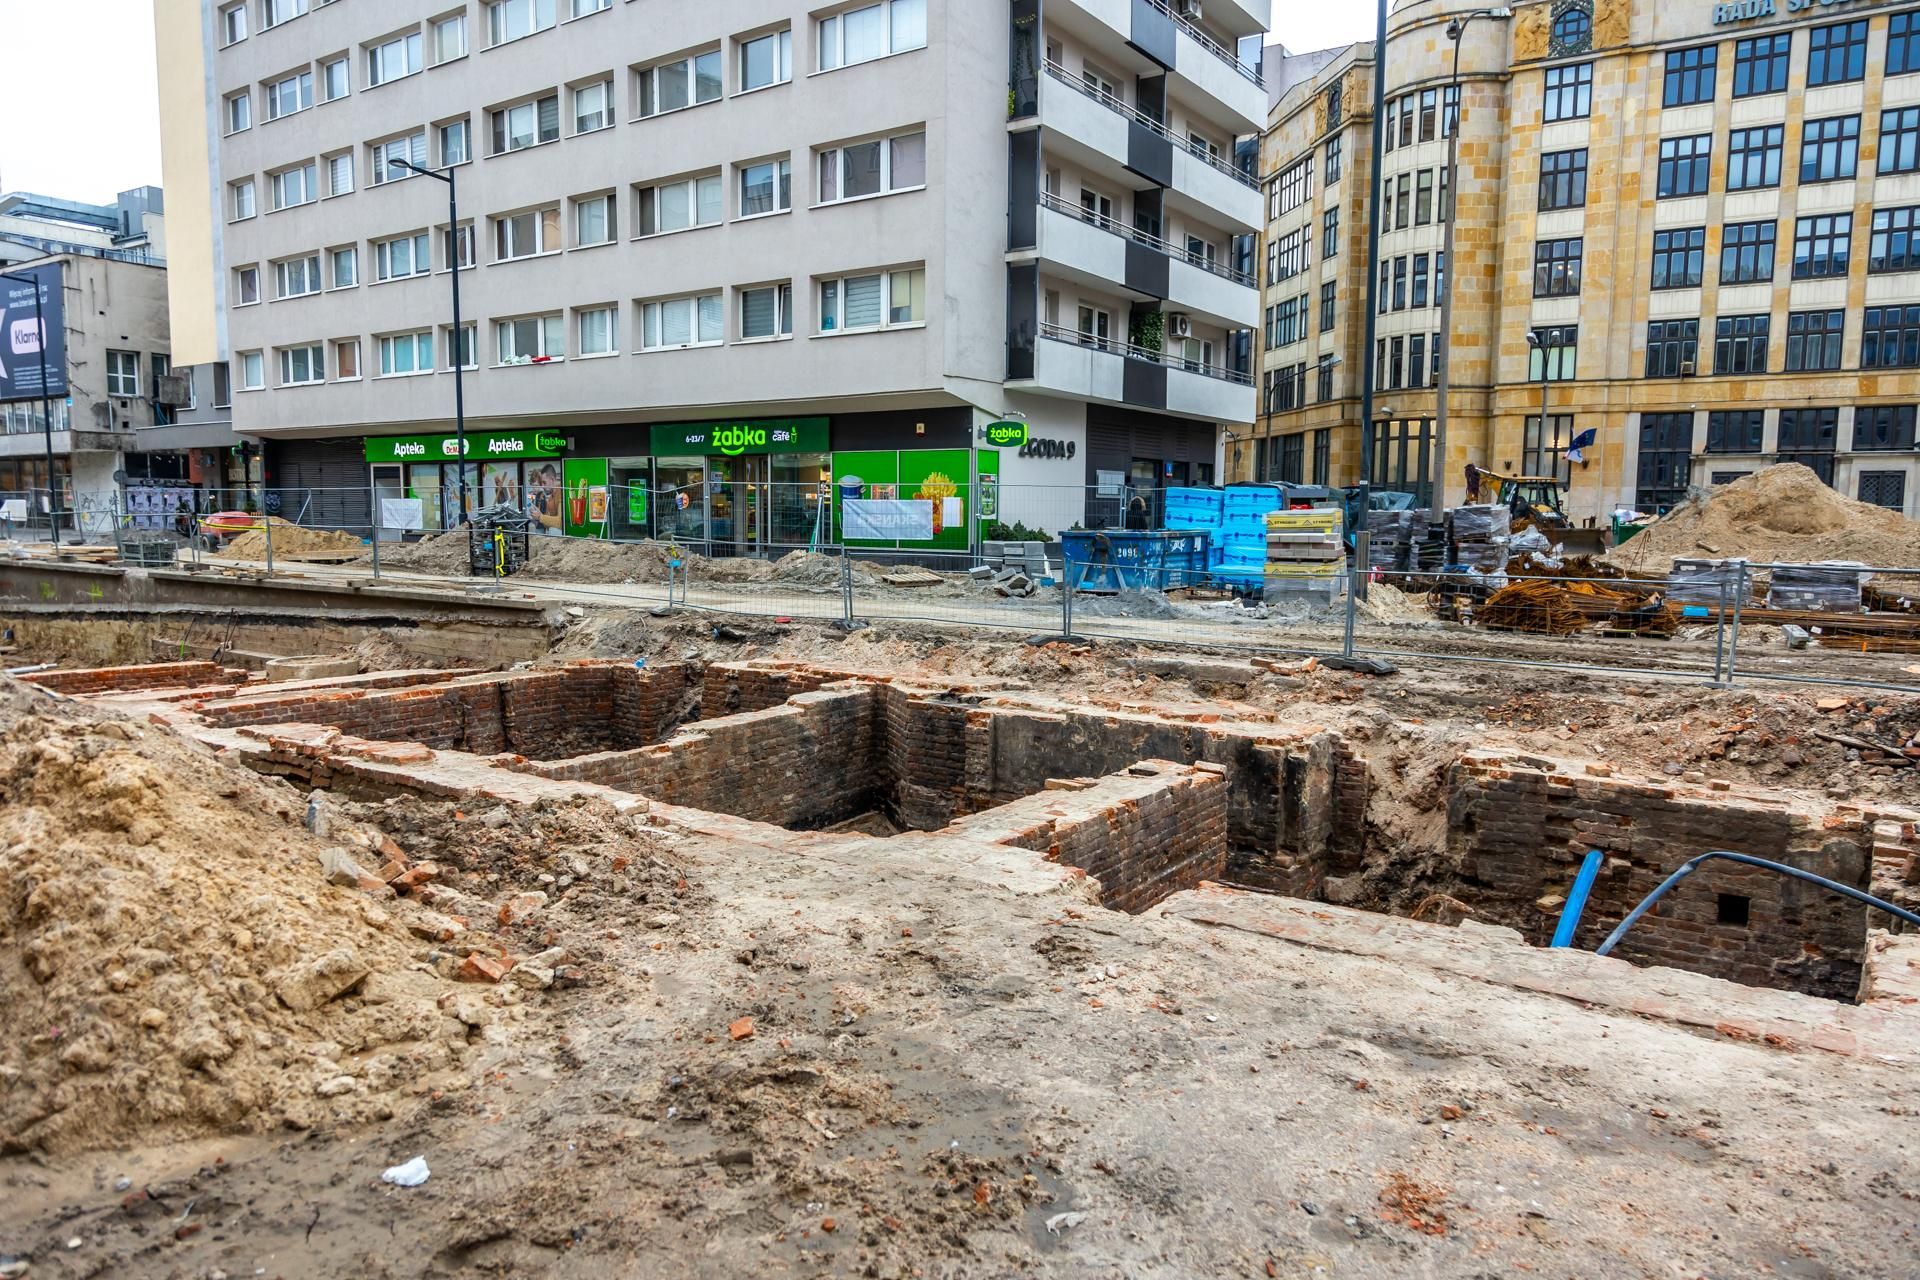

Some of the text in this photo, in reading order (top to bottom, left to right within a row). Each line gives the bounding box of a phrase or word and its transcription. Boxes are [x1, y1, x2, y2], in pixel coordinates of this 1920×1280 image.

[1713, 0, 1776, 25] RADA
[712, 426, 766, 447] żabka
[772, 431, 790, 441] café
[990, 428, 1021, 438] żabka
[394, 442, 425, 457] Apteka
[488, 438, 524, 454] Apteka
[540, 436, 566, 447] żabka
[1019, 437, 1076, 460] ZGODA 9
